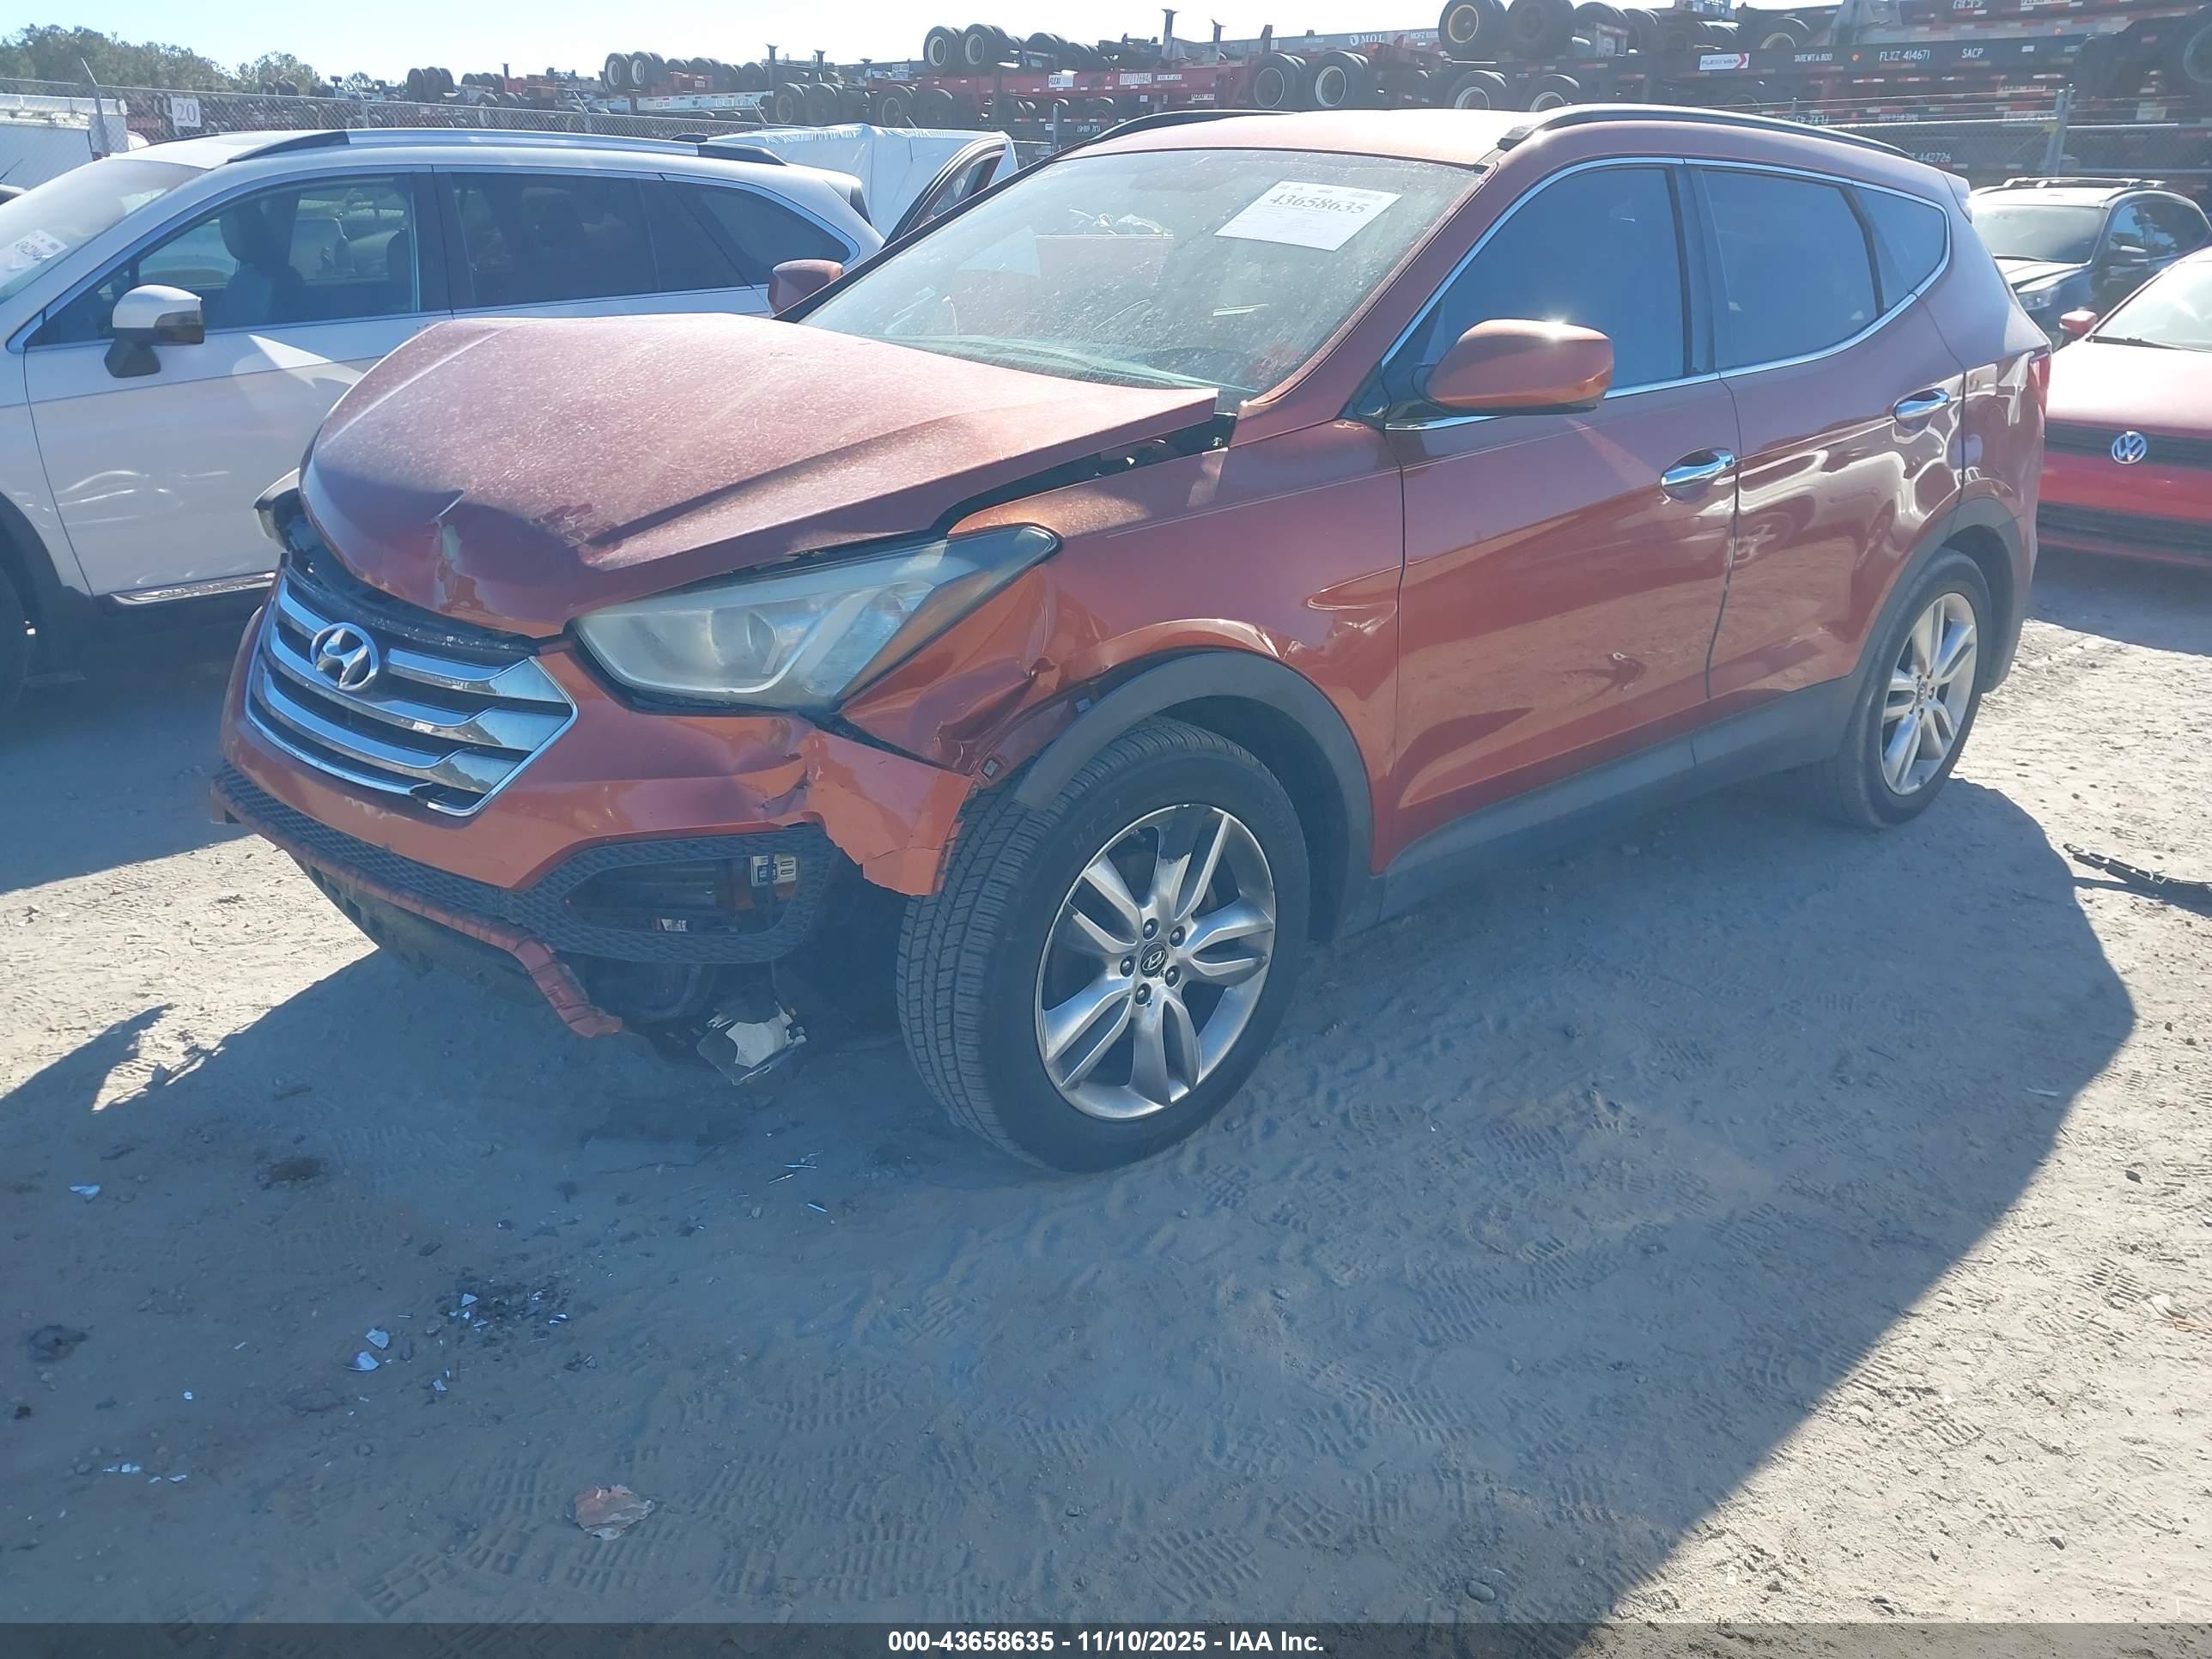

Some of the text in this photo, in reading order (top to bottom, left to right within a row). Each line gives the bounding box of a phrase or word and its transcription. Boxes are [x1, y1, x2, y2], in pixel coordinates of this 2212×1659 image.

[1880, 50, 1930, 62] FLXZ 414671
[1961, 47, 1984, 58] SACP
[176, 103, 196, 122] 20
[1270, 193, 1370, 214] 43658635
